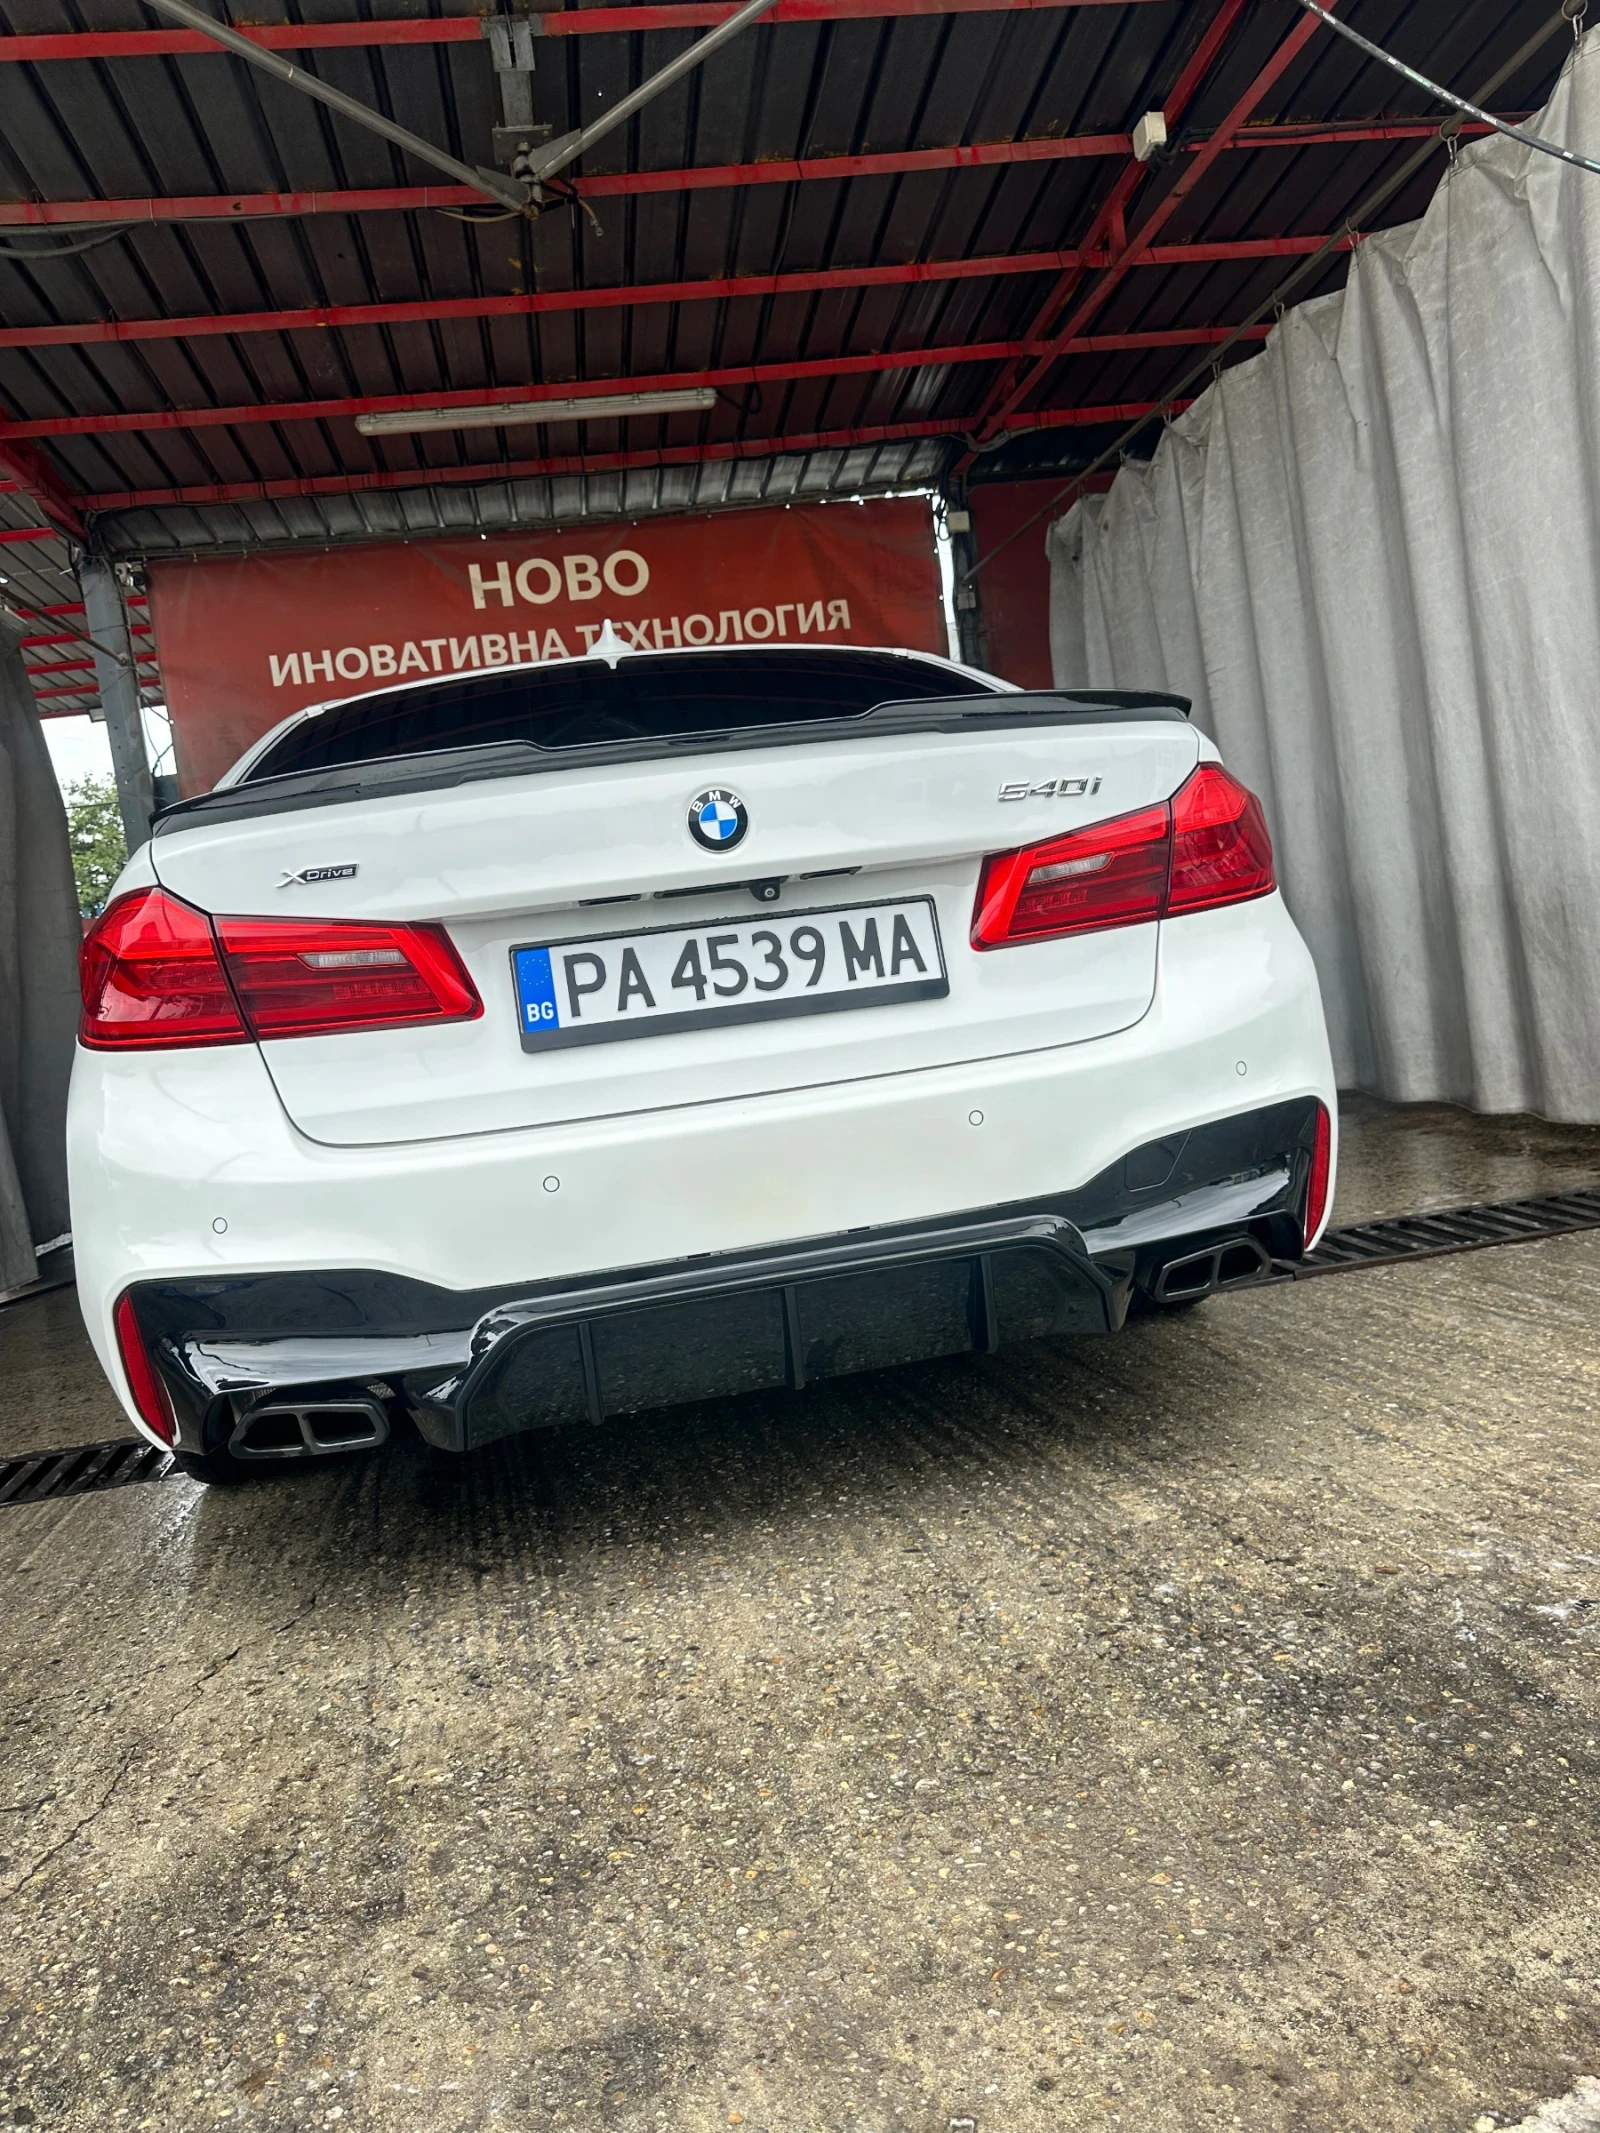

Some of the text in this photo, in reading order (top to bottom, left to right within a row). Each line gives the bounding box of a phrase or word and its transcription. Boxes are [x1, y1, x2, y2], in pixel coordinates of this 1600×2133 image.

[468, 549, 651, 609] НОВО
[268, 628, 571, 687] ИНОВАТИВНА
[691, 790, 742, 813] BMW
[998, 776, 1102, 801] 540i
[563, 914, 928, 1018] PA 4539 MA
[527, 1001, 554, 1023] BG
